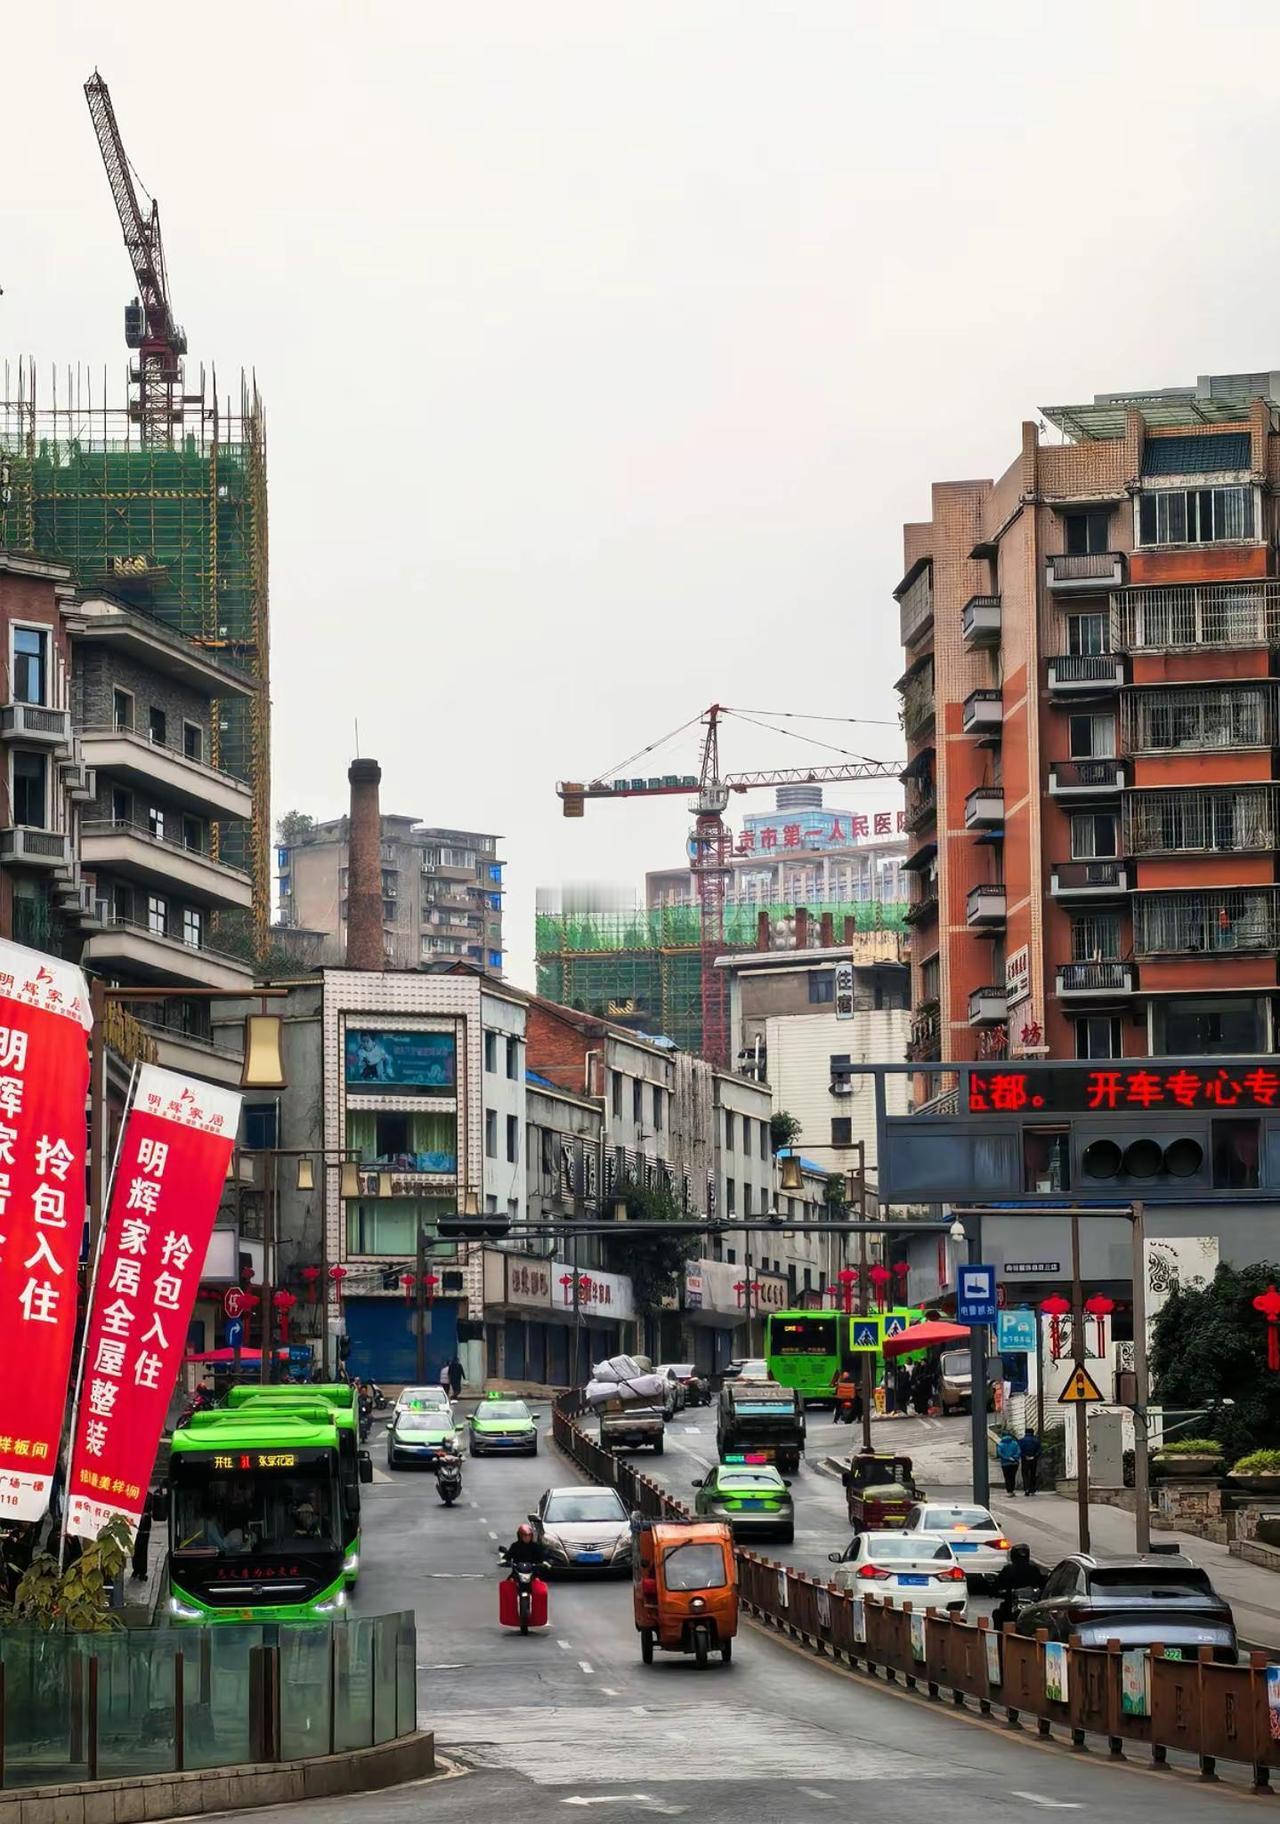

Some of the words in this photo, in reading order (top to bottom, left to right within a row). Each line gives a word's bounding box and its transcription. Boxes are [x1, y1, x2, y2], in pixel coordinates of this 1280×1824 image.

[837, 969, 852, 1013] 住宿
[147, 1093, 224, 1127] 明辉家居
[18, 1134, 75, 1324] 拎包入住
[86, 1137, 169, 1457] 明辉家居全屋整装
[134, 1230, 193, 1390] 拎包入住
[1003, 1315, 1016, 1332] P
